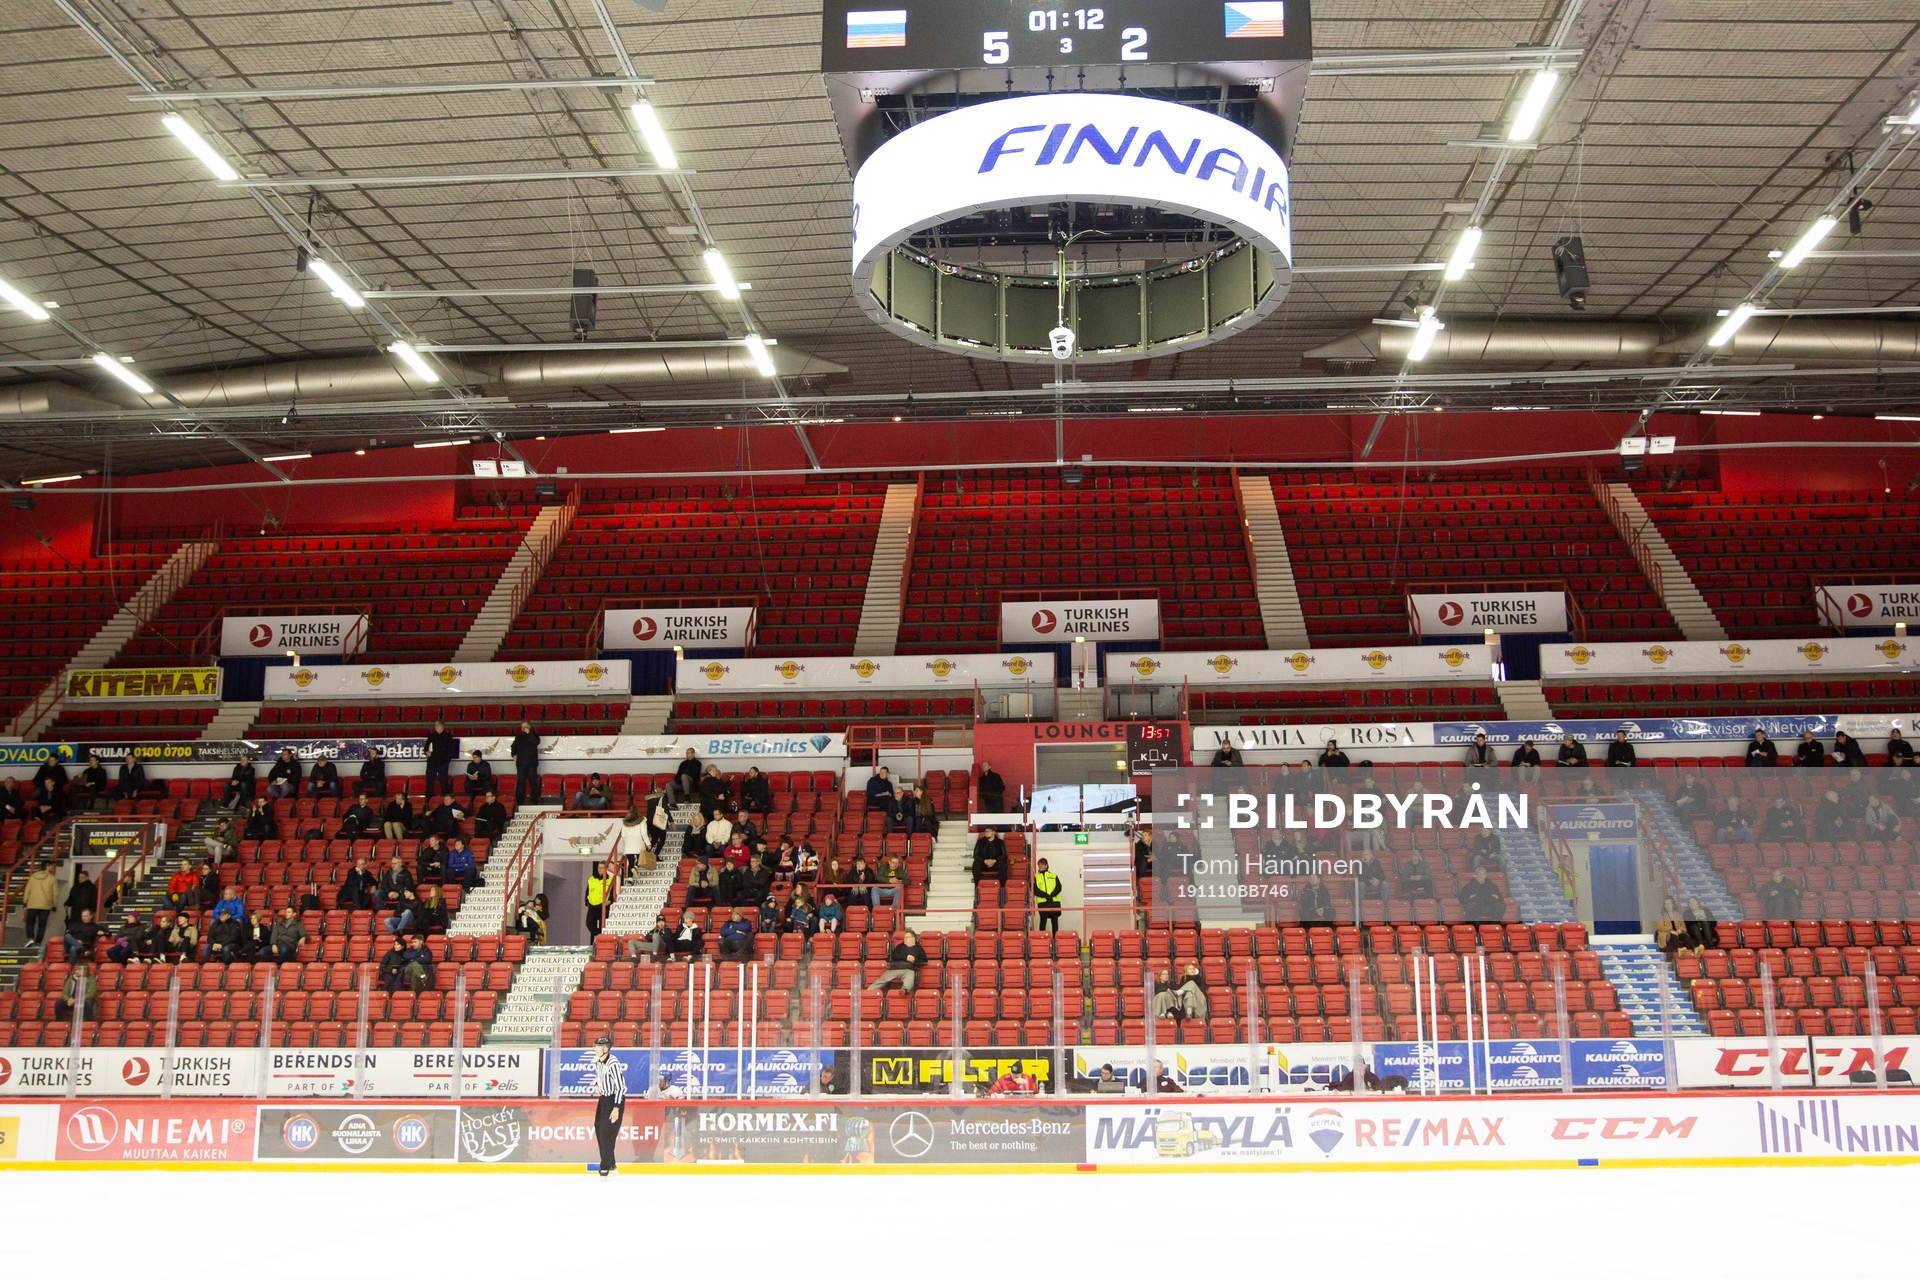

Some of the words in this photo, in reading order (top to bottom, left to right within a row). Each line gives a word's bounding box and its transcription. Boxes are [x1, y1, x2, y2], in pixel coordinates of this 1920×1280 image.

[983, 32, 1010, 64] 5
[1060, 37, 1073, 53] 3
[1121, 27, 1148, 60] 2
[977, 122, 1288, 227] FINNAIR
[1471, 600, 1536, 613] TURKISH
[1064, 608, 1129, 620] TURKISH
[1471, 613, 1538, 626] AIRLINES
[280, 622, 340, 635] TURKISH
[665, 615, 728, 628] TURKISH
[1064, 620, 1130, 633] AIRLINES
[278, 635, 340, 648] AIRLINES
[663, 628, 728, 641] AIRLINES
[68, 673, 218, 697] KITEMA.fi
[1034, 724, 1124, 738] LOUNGE
[1141, 725, 1170, 739] 13:57
[1214, 729, 1305, 745] MAMMA
[1351, 727, 1415, 744] ROSA
[134, 747, 160, 757] 0100
[164, 746, 192, 757] 0700
[1140, 753, 1148, 761] K
[1161, 753, 1168, 761] V
[1585, 1052, 1663, 1063] KAUKOKIITO
[872, 1058, 913, 1084] M
[428, 1083, 450, 1091] PAR
[497, 1079, 519, 1091] elis
[1587, 1075, 1666, 1086] KAUKOKIITO
[461, 1106, 514, 1132] HOCKEY
[699, 1112, 838, 1132] HORMEX.FI
[291, 1125, 313, 1142] HK
[401, 1125, 422, 1142] HK
[528, 1125, 659, 1140] HOCKEYSE.FI
[950, 1118, 1070, 1136] Mercedes-Benz
[1355, 1117, 1506, 1147] RE/MAX
[1550, 1116, 1698, 1140] CCM
[464, 1121, 520, 1152] BASE
[950, 1140, 967, 1150] The
[968, 1140, 988, 1150] best
[989, 1142, 999, 1150] or
[1001, 1140, 1038, 1152] nothing.
[122, 1149, 178, 1159] MUUTTAA
[183, 1149, 227, 1159] KAIKEN
